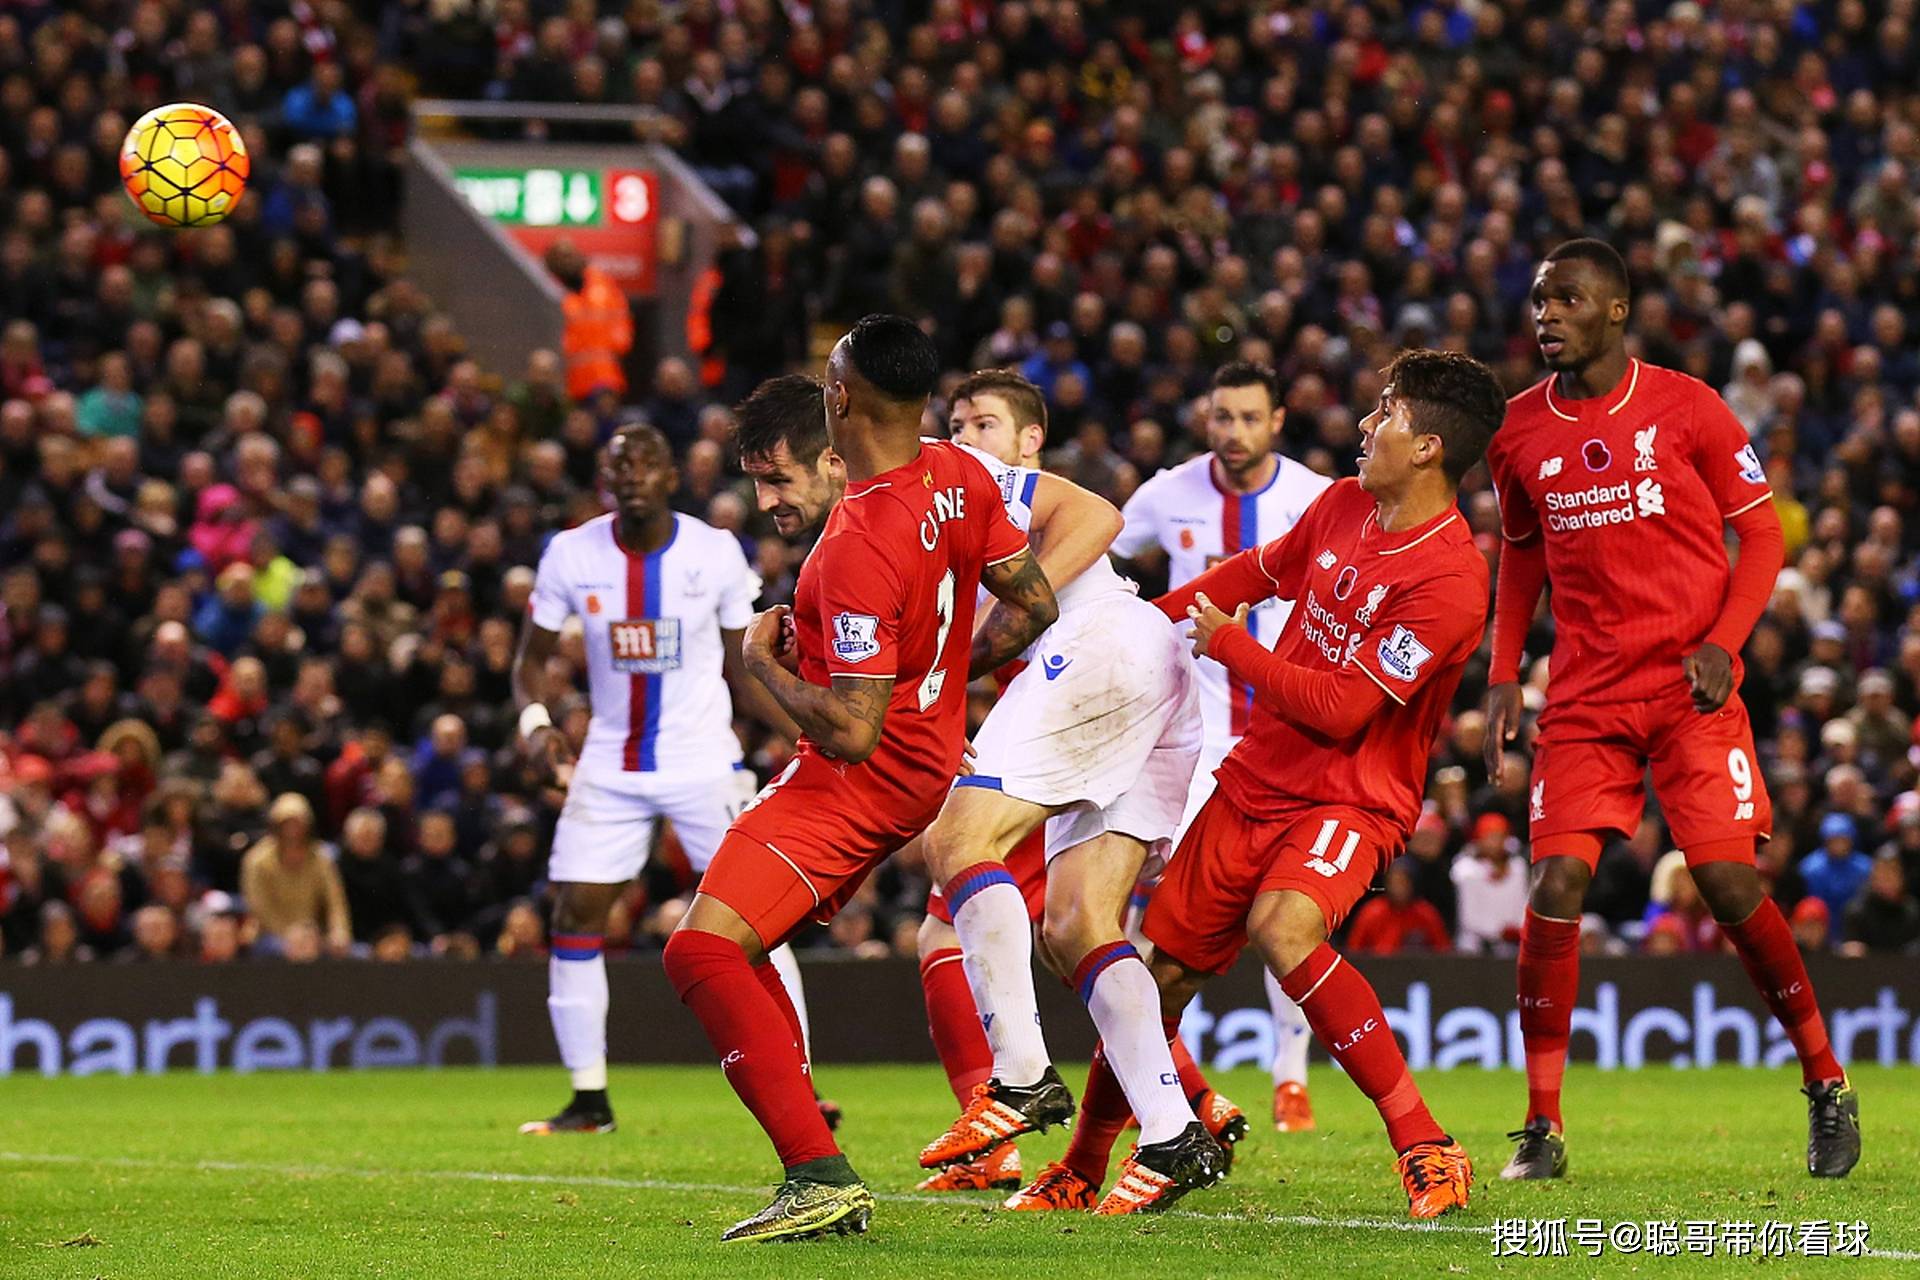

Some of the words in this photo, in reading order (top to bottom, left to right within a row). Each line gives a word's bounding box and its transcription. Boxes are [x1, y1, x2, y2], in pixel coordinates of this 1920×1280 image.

[613, 174, 649, 222] 3
[1545, 479, 1631, 511] Standard
[1548, 502, 1634, 531] Chartered
[918, 567, 955, 712] 2
[1728, 747, 1752, 801] 9
[1308, 819, 1361, 873] 11
